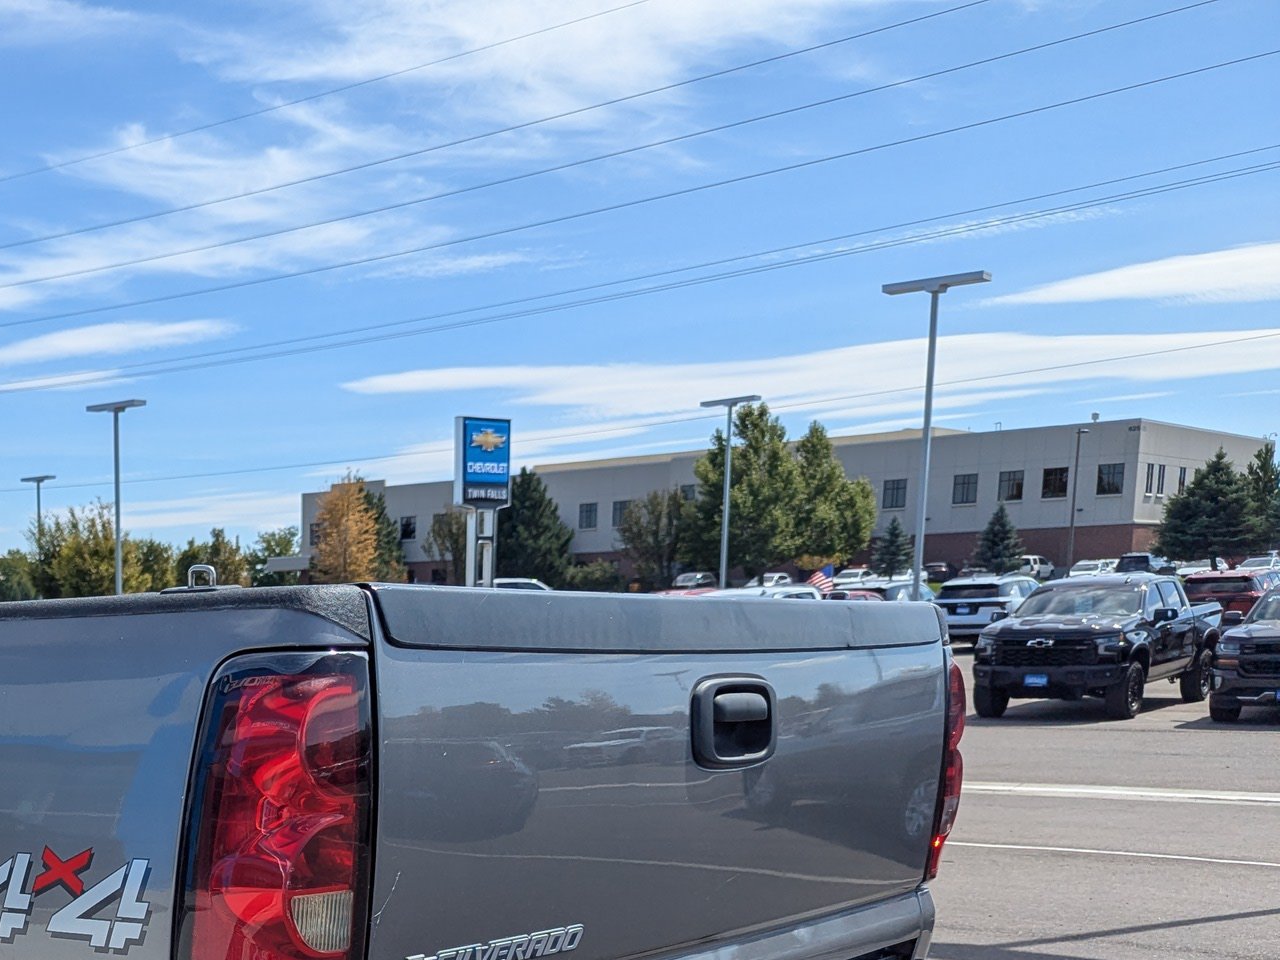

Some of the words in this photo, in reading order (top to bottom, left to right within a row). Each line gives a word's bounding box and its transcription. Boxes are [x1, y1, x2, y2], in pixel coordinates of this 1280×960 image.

[467, 461, 507, 474] CHEVROLET
[468, 488, 485, 499] TWIN
[487, 488, 507, 500] FALLS
